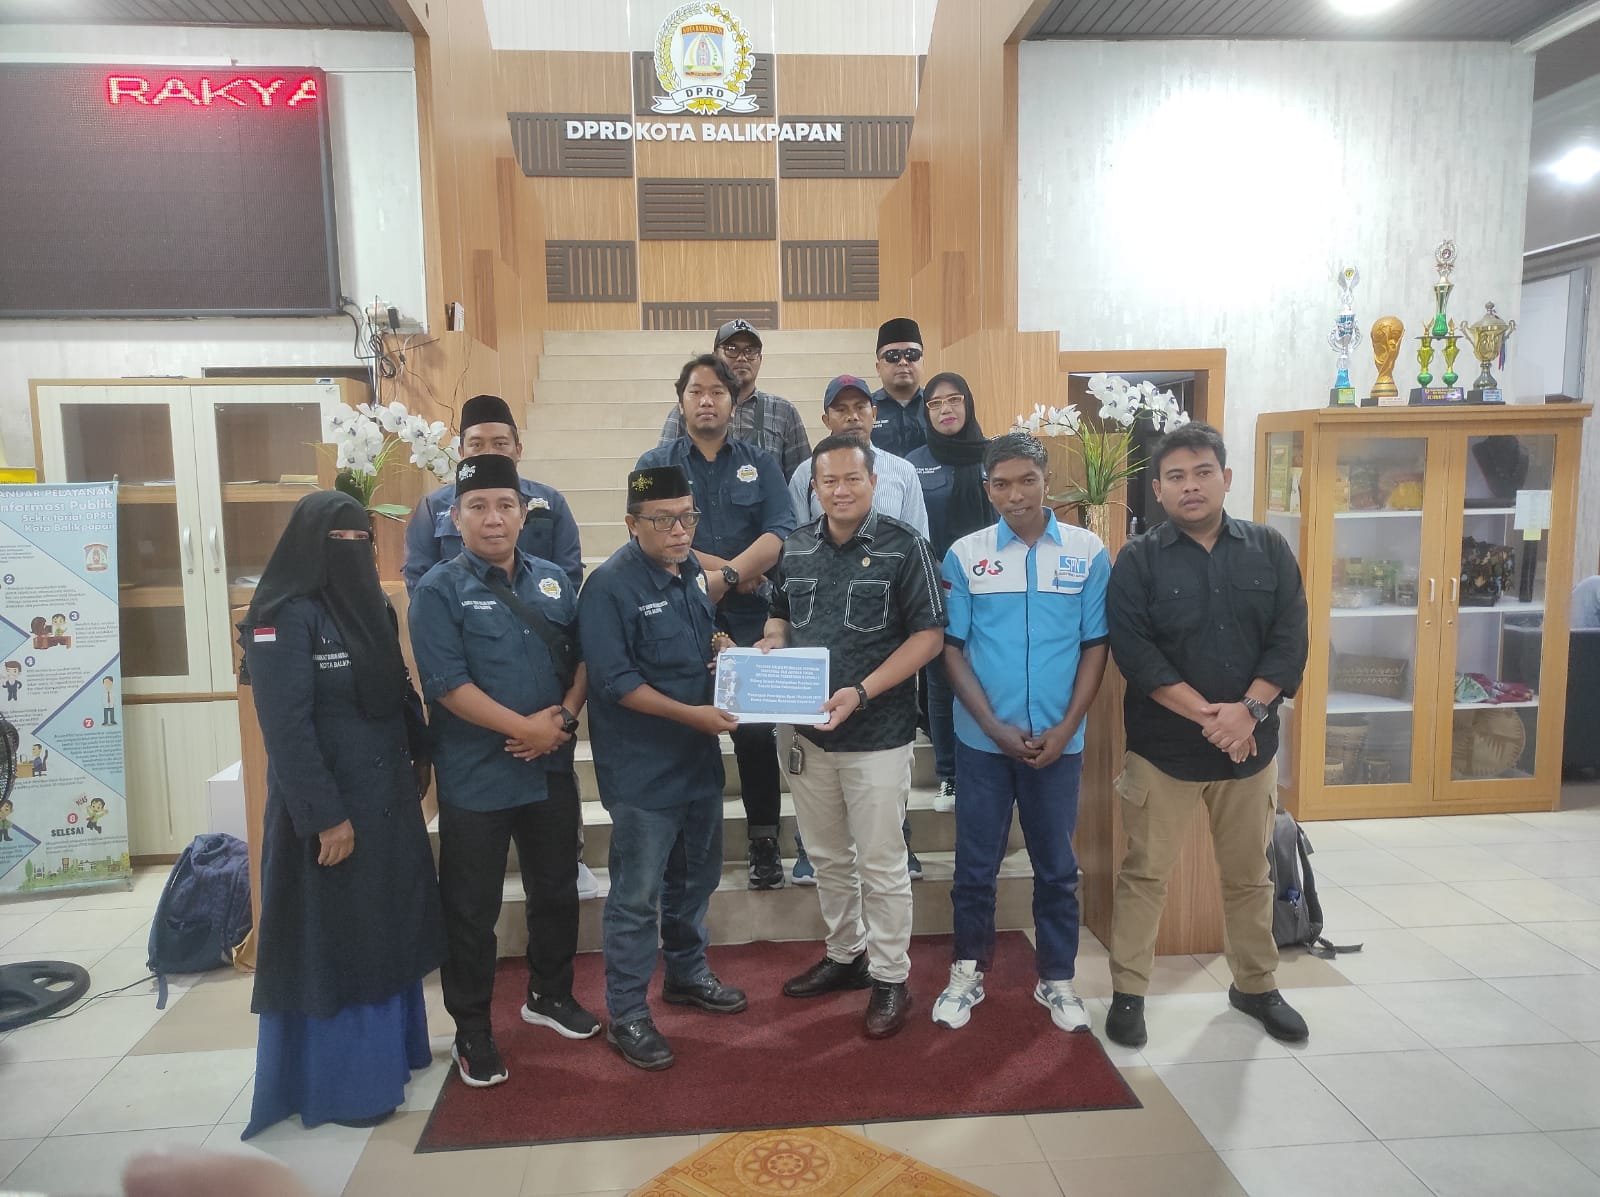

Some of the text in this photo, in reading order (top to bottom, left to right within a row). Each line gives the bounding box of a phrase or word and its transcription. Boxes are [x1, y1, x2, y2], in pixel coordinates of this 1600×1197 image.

[108, 75, 317, 106] RAKYA
[685, 87, 724, 98] DPRD
[566, 120, 842, 143] DPRD KOTA BALIKPAPAN
[71, 500, 112, 510] Publik
[51, 825, 84, 837] SELESAI
